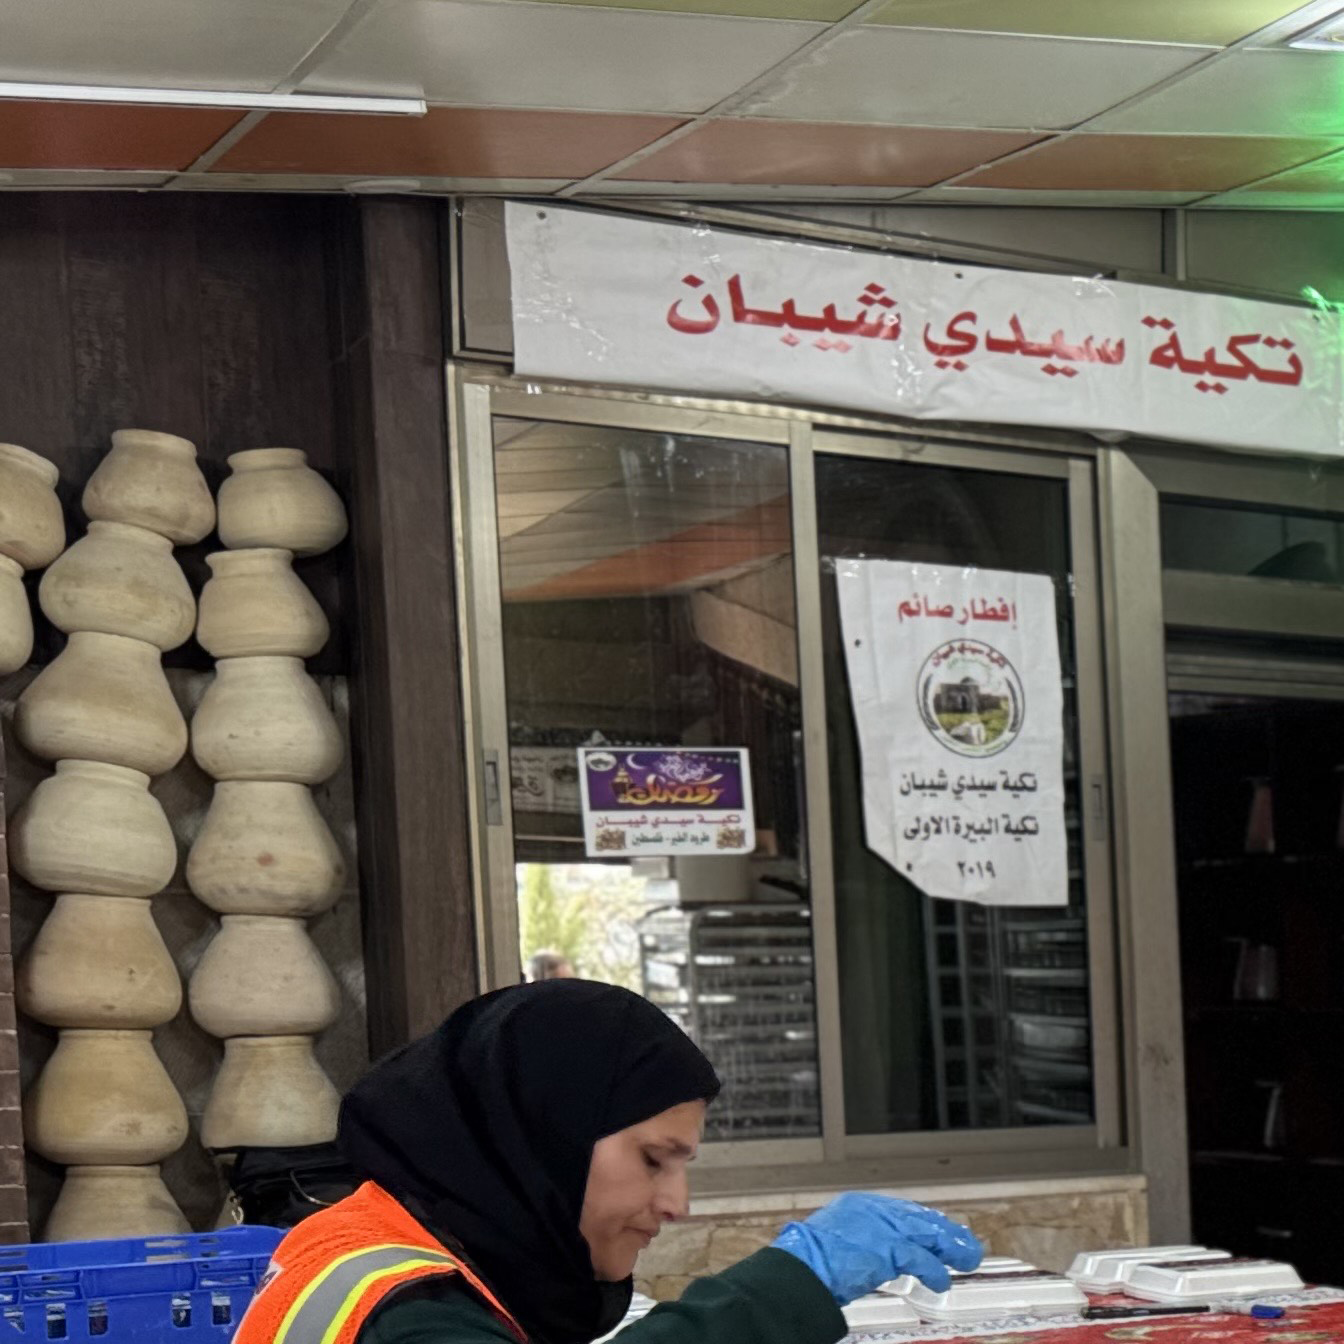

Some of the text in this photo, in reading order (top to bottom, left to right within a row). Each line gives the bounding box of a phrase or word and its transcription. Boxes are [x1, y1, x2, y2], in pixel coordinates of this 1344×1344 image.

[665, 273, 1304, 395] تكية سيدي شيبان
[900, 768, 1038, 801] تكية سيدي شيبان
[1001, 813, 1039, 843] تكية
